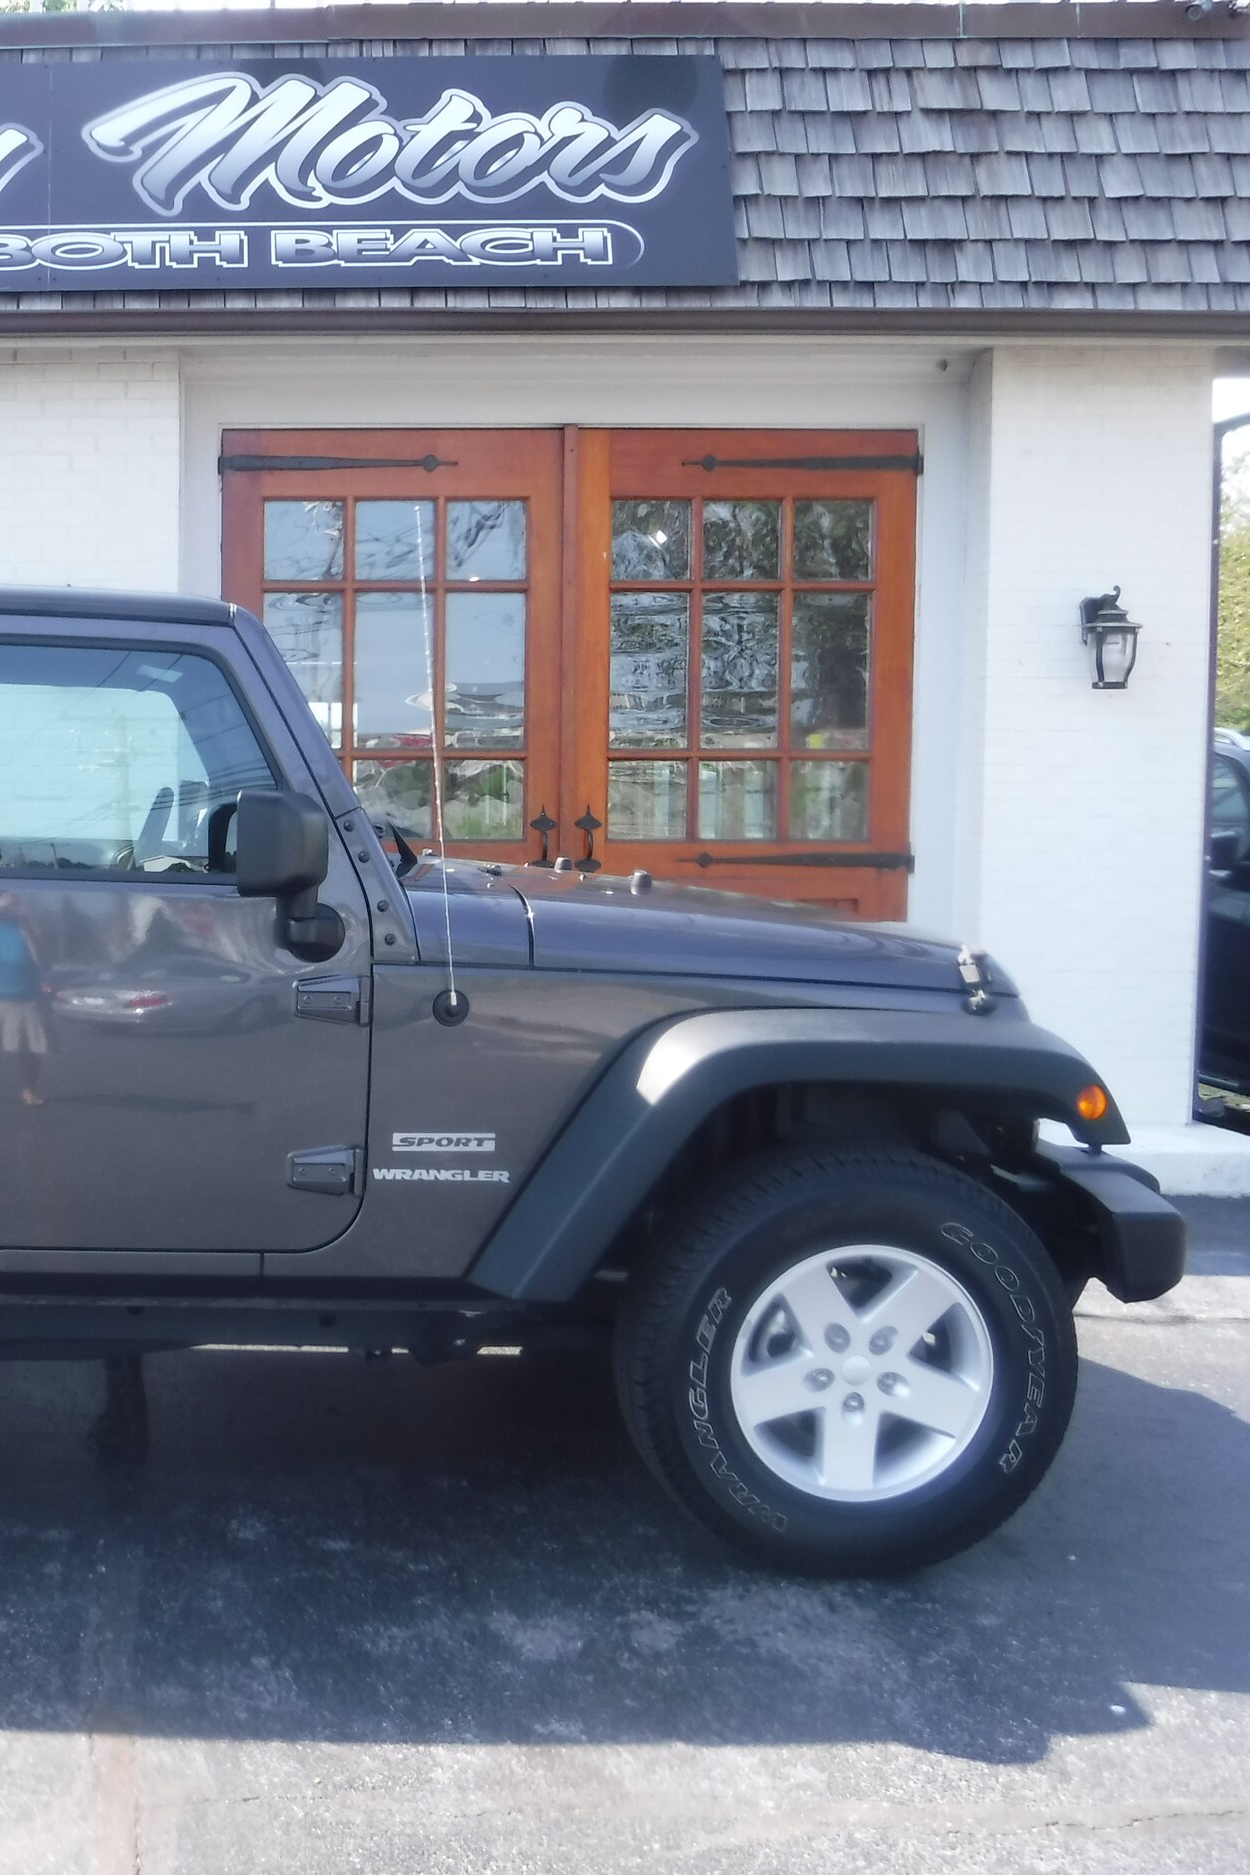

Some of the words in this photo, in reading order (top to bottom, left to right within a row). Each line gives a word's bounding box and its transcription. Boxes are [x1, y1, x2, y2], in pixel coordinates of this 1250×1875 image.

[81, 71, 700, 217] Motors
[270, 227, 614, 269] BEACH
[372, 1168, 511, 1184] WRANGLER
[393, 1135, 496, 1149] SPORT
[940, 1221, 1046, 1474] GOODYEAR
[688, 1287, 788, 1533] WRANGLER
